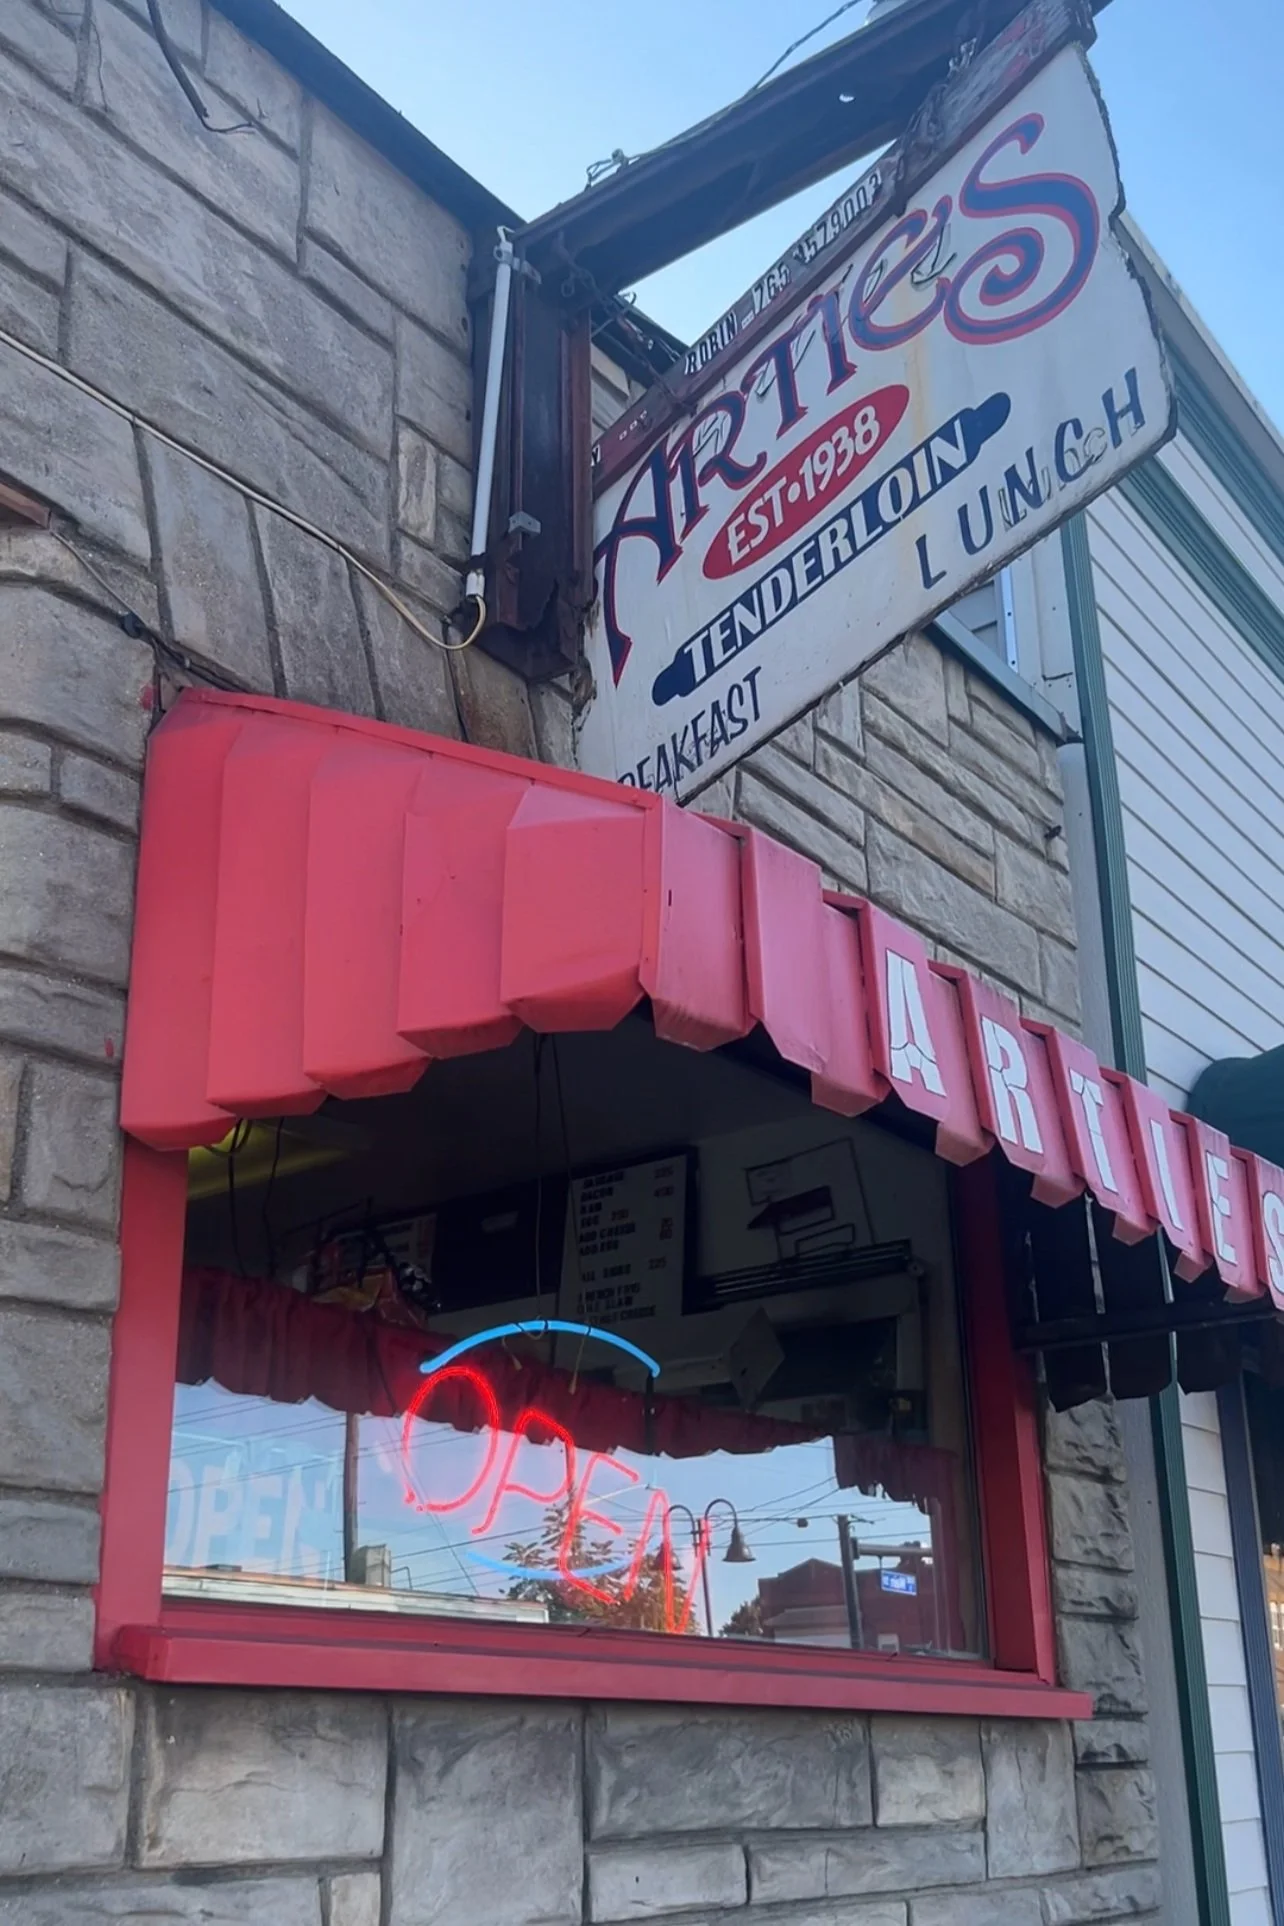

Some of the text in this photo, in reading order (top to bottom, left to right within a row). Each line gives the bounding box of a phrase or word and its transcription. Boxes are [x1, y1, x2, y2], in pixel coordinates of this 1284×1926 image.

[684, 312, 738, 375] ROBIN
[752, 262, 793, 314] 765
[684, 419, 969, 684] TENDERLOIN
[916, 367, 1146, 590] LUNCH
[402, 1366, 709, 1634] OPEN
